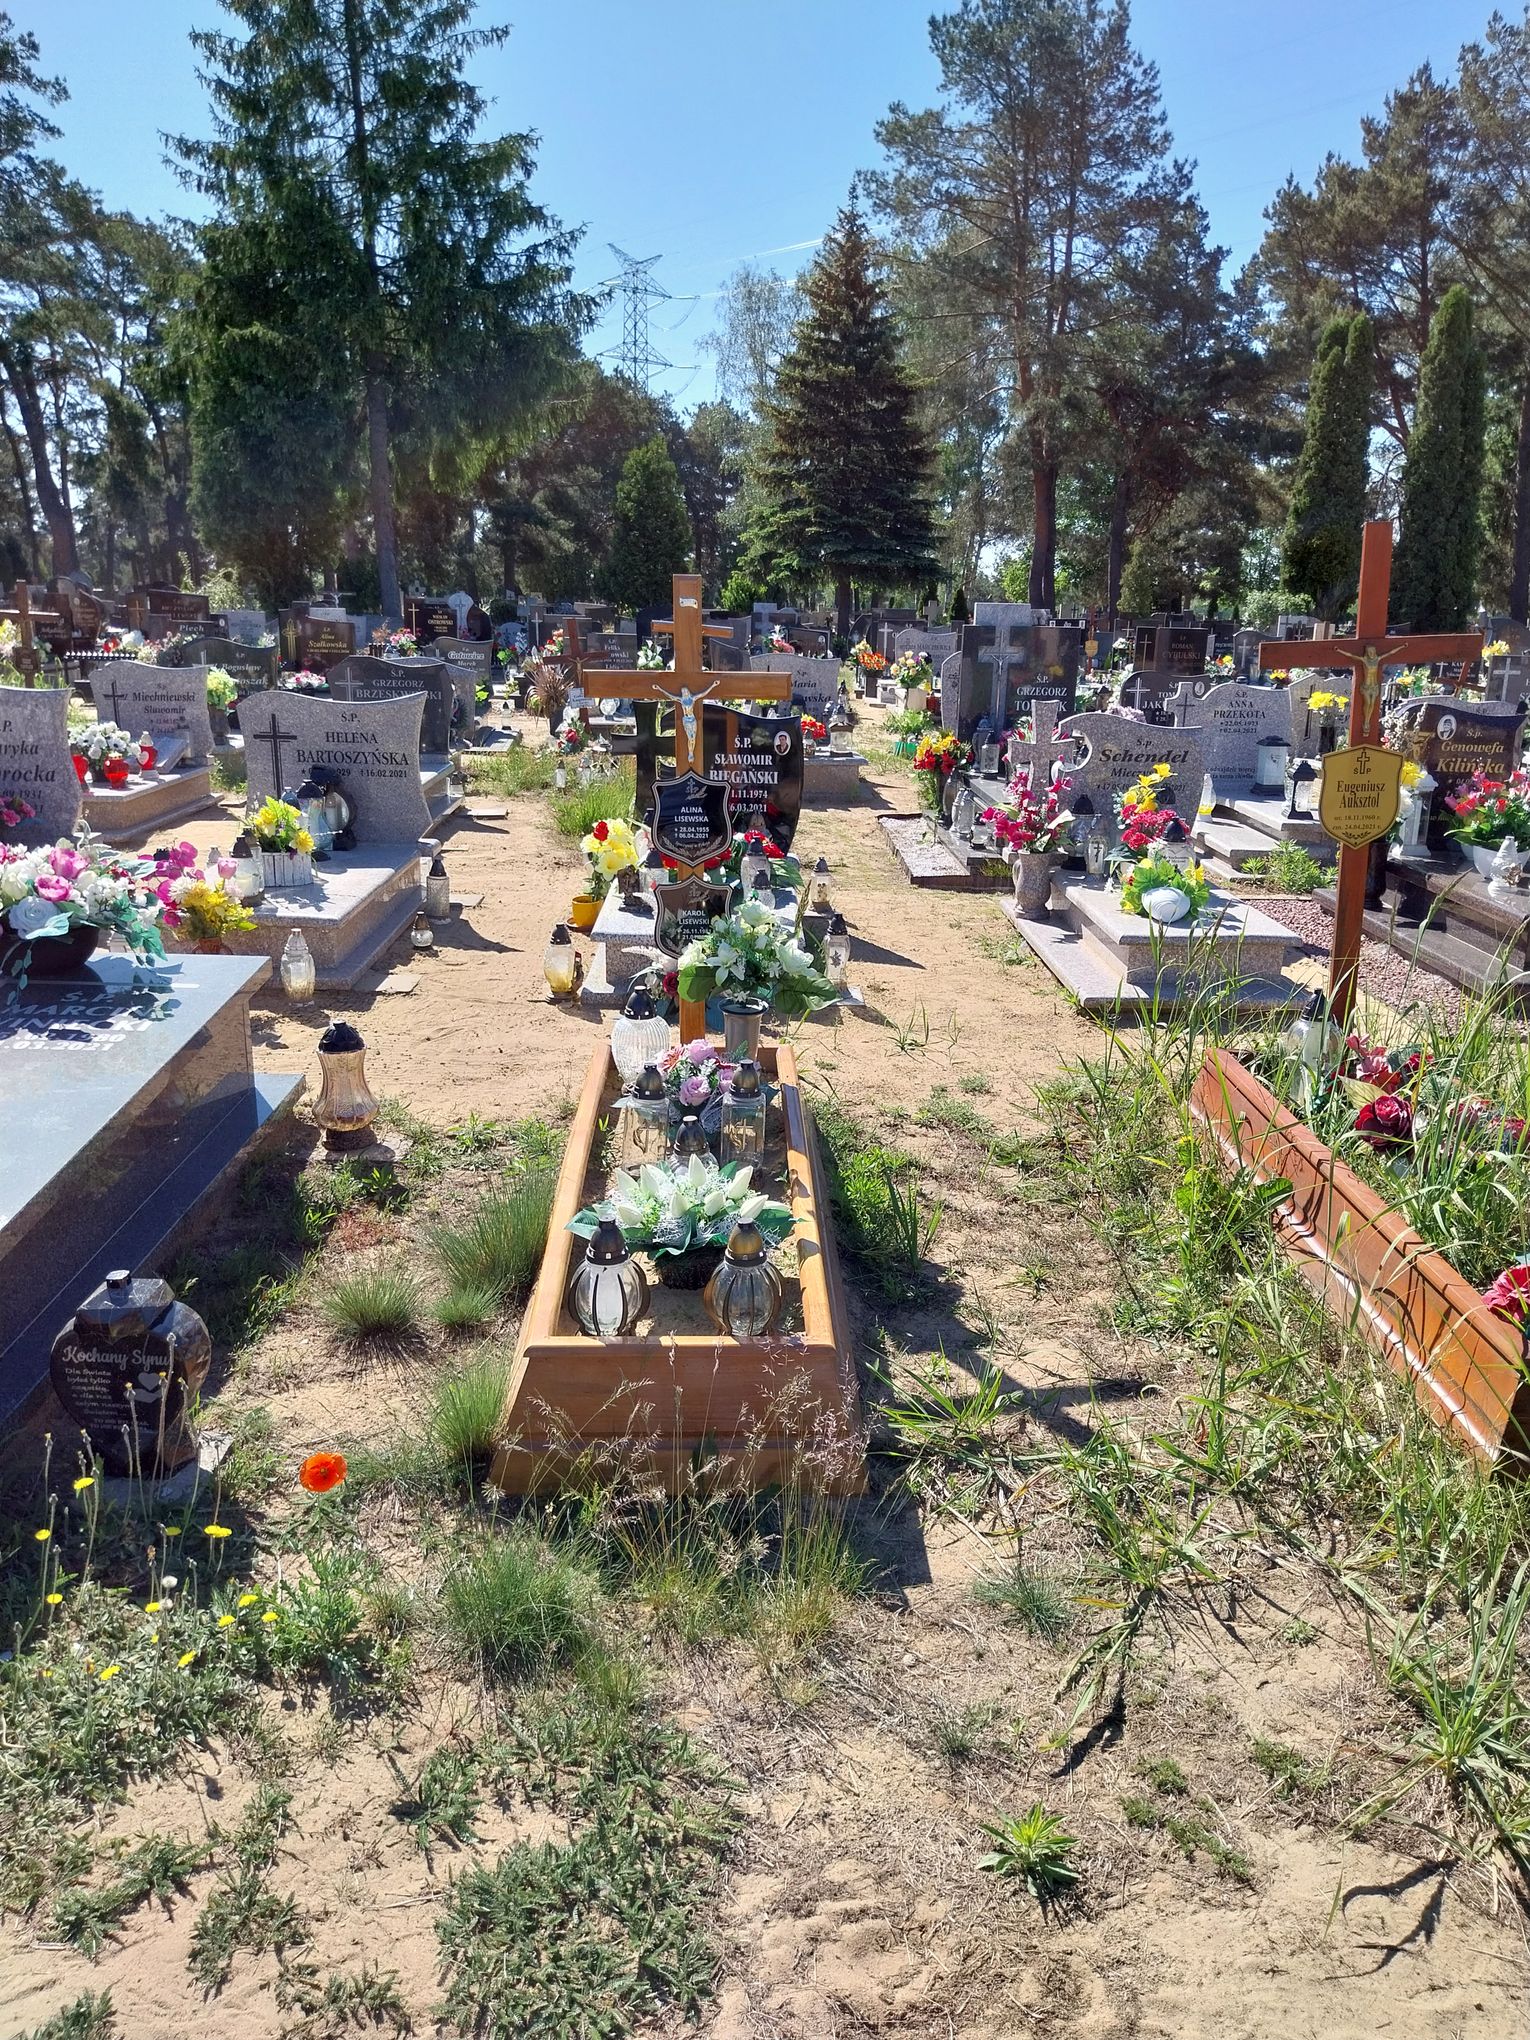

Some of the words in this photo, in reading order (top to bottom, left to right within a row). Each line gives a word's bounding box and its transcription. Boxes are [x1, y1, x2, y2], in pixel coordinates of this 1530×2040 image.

[373, 679, 425, 688] GRZEGORZ
[356, 688, 442, 701] BRZESKWSKI
[1016, 687, 1067, 696] GRZEGORZ
[1213, 710, 1266, 719] PRZEKOTA
[325, 731, 378, 744] HELENA
[1441, 740, 1504, 755] Genowefa
[297, 748, 409, 766] BARTOSZYŃSKA
[715, 754, 773, 766] SŁAWOMIR
[1099, 749, 1189, 764] Schendel
[1337, 780, 1386, 795] Eugeniusz
[729, 803, 768, 812] 6.03.2021
[682, 909, 706, 917] KAROL
[62, 1345, 129, 1371] Kochany
[131, 1349, 170, 1372] Synu
